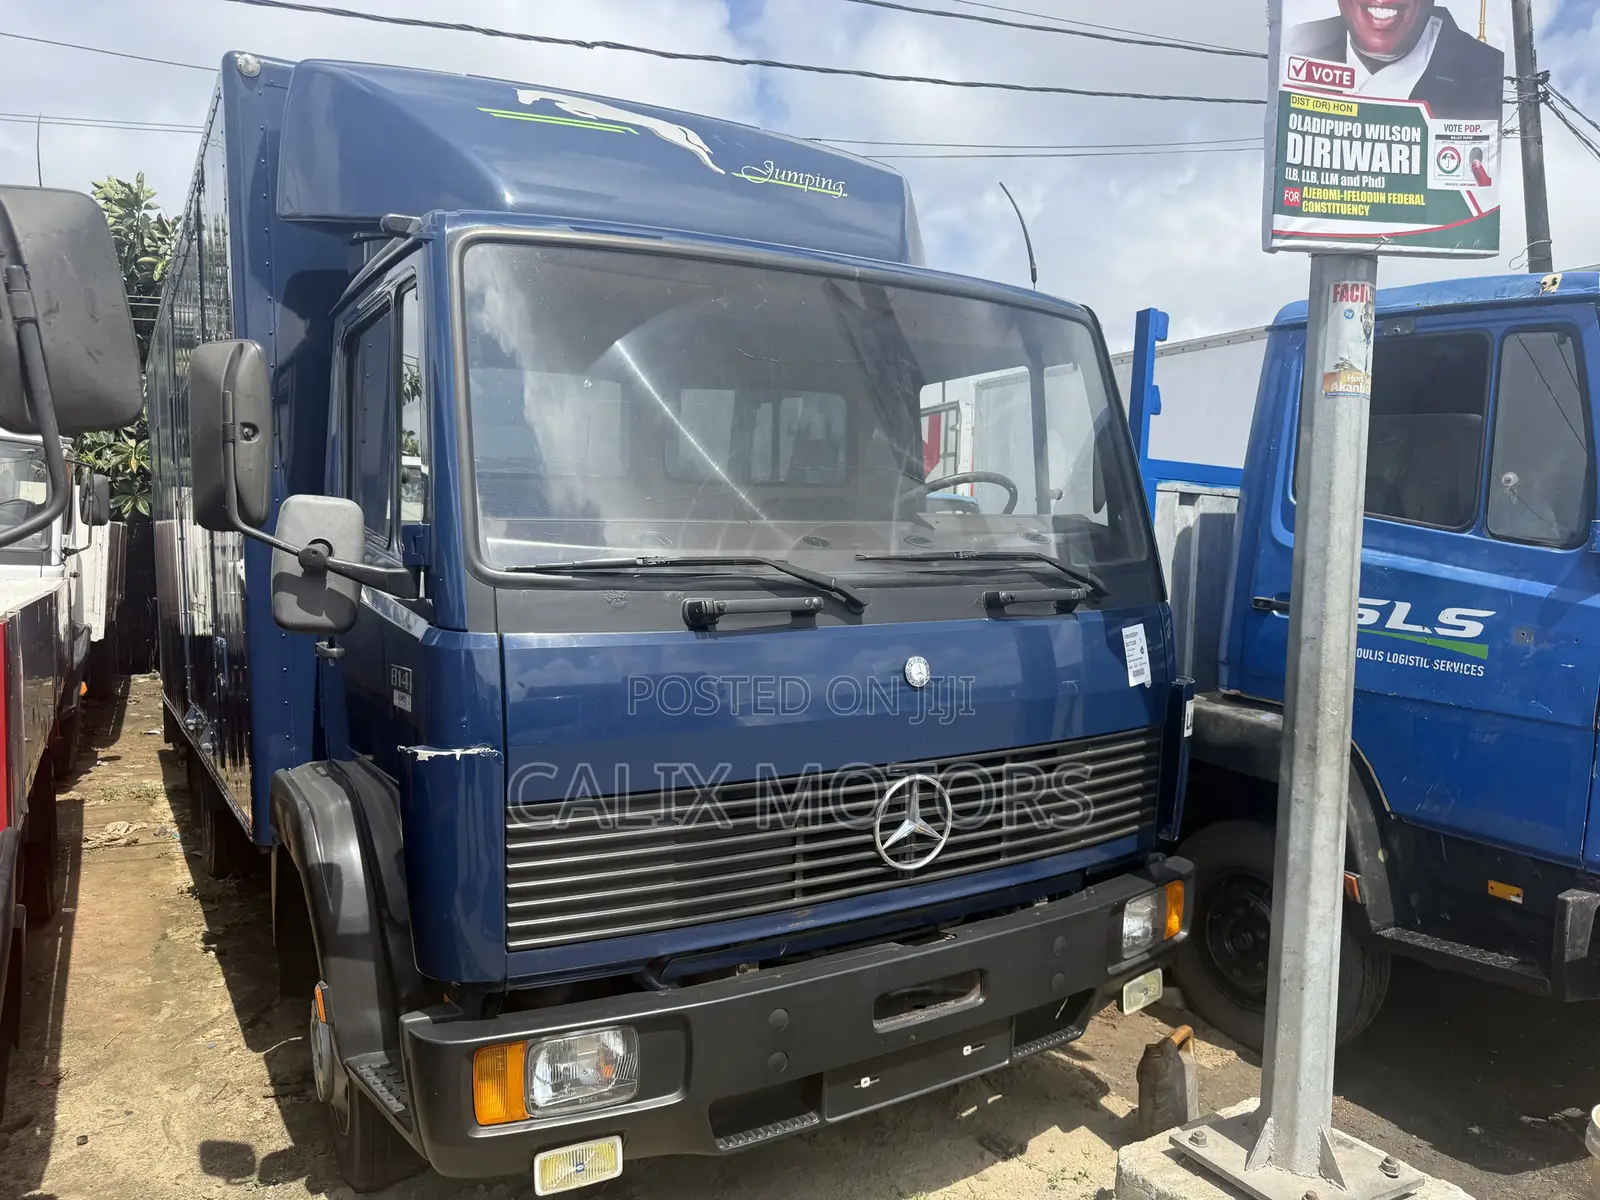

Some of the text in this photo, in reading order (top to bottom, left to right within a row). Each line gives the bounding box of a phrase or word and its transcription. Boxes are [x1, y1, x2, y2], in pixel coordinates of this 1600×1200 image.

[1312, 66, 1352, 85] VOTE
[1291, 95, 1353, 113] DIST (DR) HON
[1288, 113, 1421, 143] OLADIPUPO WILSON
[1443, 124, 1483, 133] VOTE PDP.
[1286, 131, 1421, 175] DIRIWARI
[741, 160, 846, 198] Jumping
[1302, 170, 1319, 185] LLB,
[1320, 172, 1339, 186] LLM
[1341, 174, 1360, 187] and
[1362, 176, 1386, 188] Phd)
[1284, 190, 1300, 202] FOR
[1302, 187, 1426, 206] AJEROMI-IFELODUN FEDERAL
[1302, 201, 1370, 216] CONSTITUENCY
[1358, 597, 1497, 638] SLS
[1356, 647, 1485, 677] OULIS LOGISTIC SERVICES
[391, 667, 409, 690] 814
